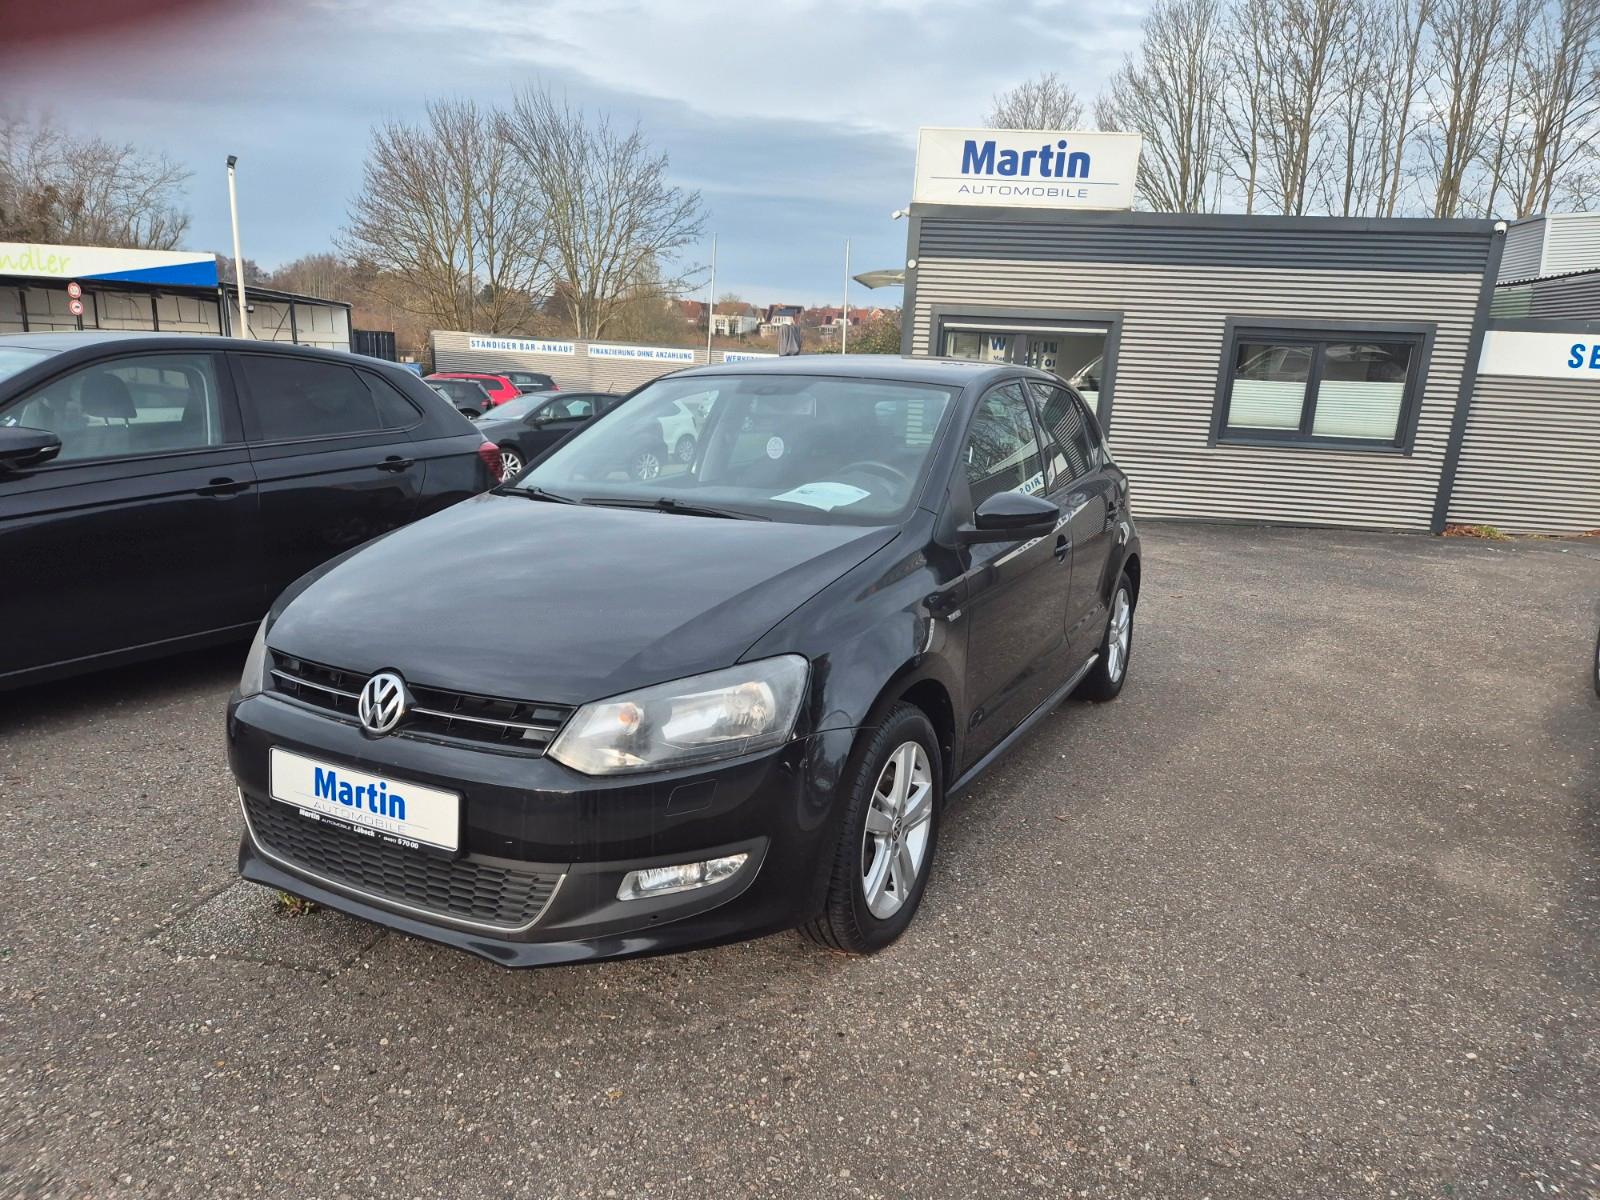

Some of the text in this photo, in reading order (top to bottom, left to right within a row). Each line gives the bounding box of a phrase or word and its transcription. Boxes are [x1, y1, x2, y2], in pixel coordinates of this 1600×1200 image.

[961, 139, 1091, 179] Martin
[958, 184, 1088, 199] AUTOMOBILE
[589, 347, 692, 360] FINANZIERUNG OHNE ANZAHLUNG
[314, 767, 406, 820] Martin
[313, 800, 408, 834] AUTOMOBILE
